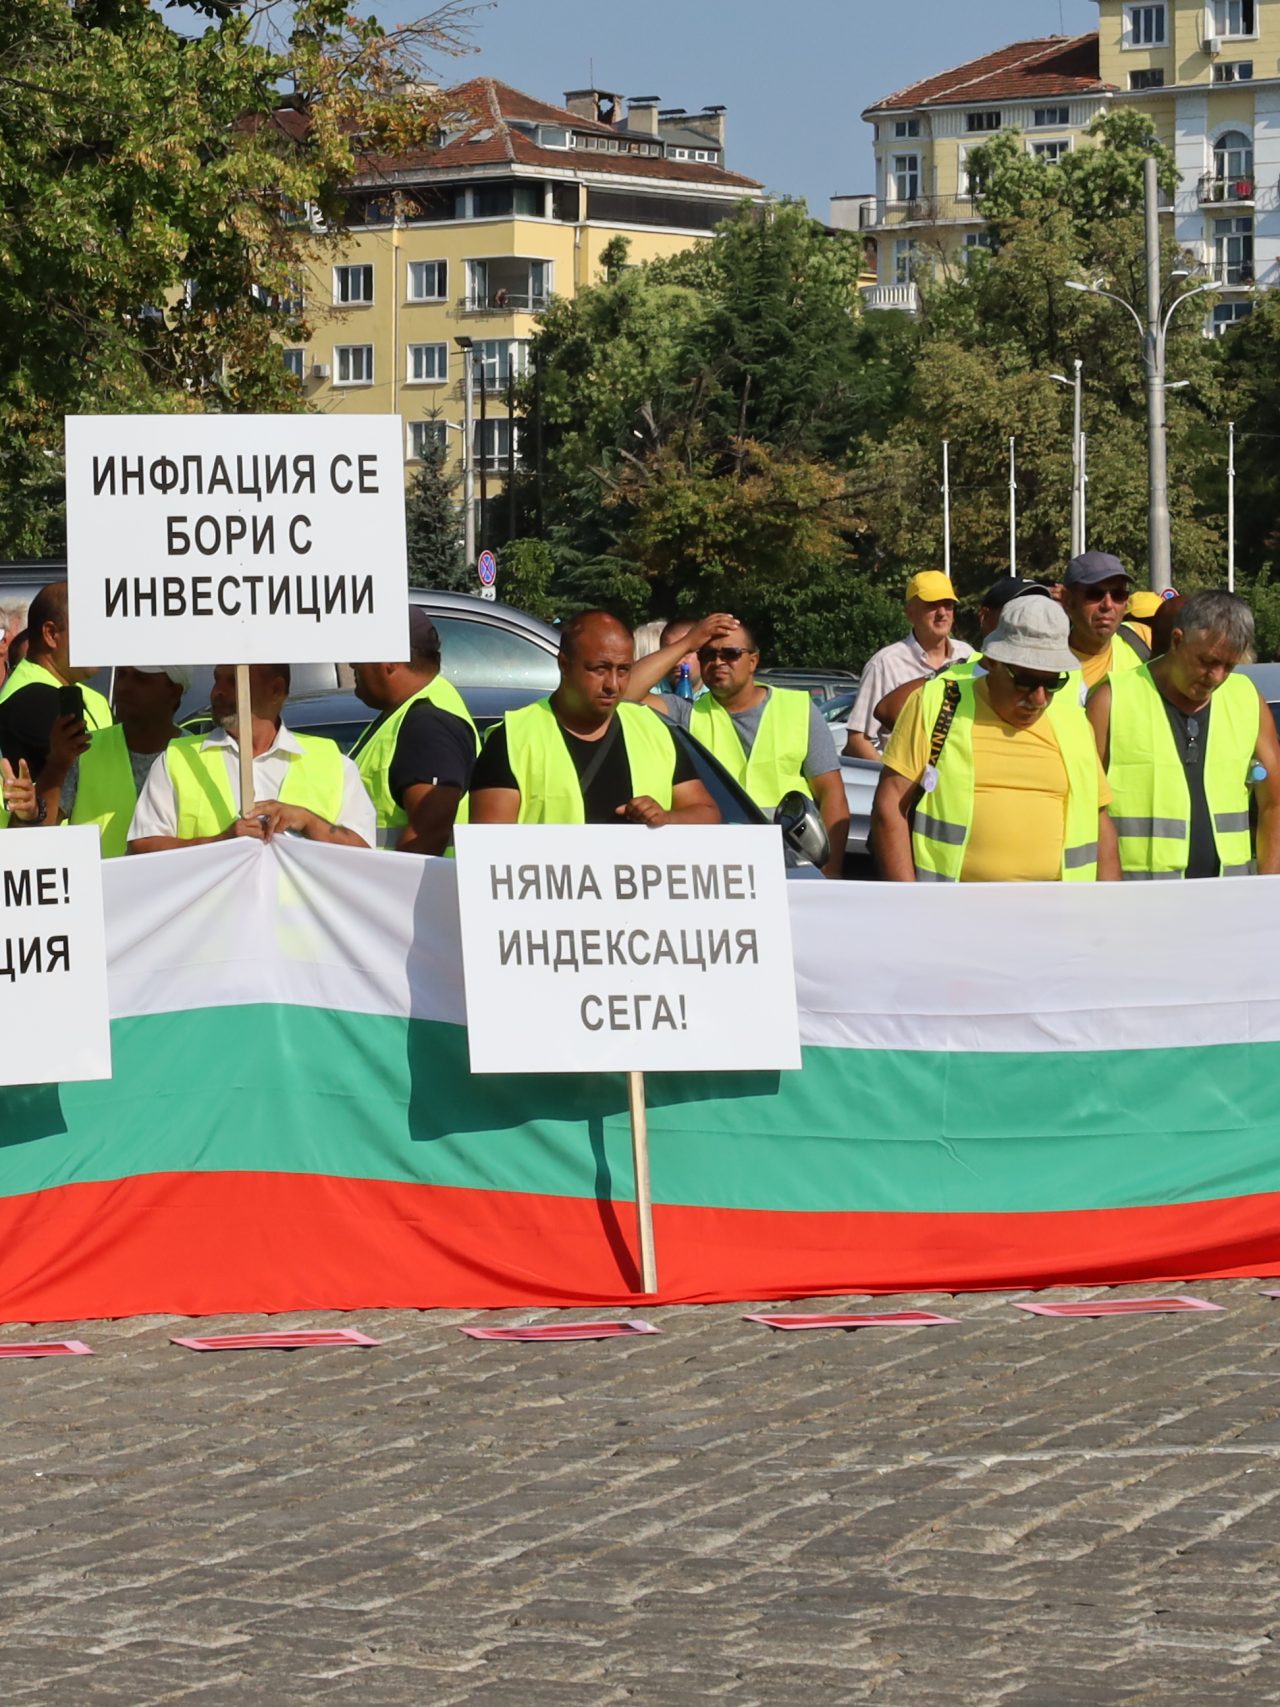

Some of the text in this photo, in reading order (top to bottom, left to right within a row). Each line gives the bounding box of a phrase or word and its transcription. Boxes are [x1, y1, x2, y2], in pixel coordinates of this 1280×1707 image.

[92, 453, 379, 503] ИНФЛАЦИЯ СЕ
[166, 514, 313, 556] БОРИ С
[104, 574, 374, 623] ИНВЕСТИЦИИ
[489, 864, 757, 901] НЯМА ВРЕМЕ!
[498, 928, 759, 973] ИНДЕКСАЦИЯ
[580, 994, 688, 1032] СЕГА!
